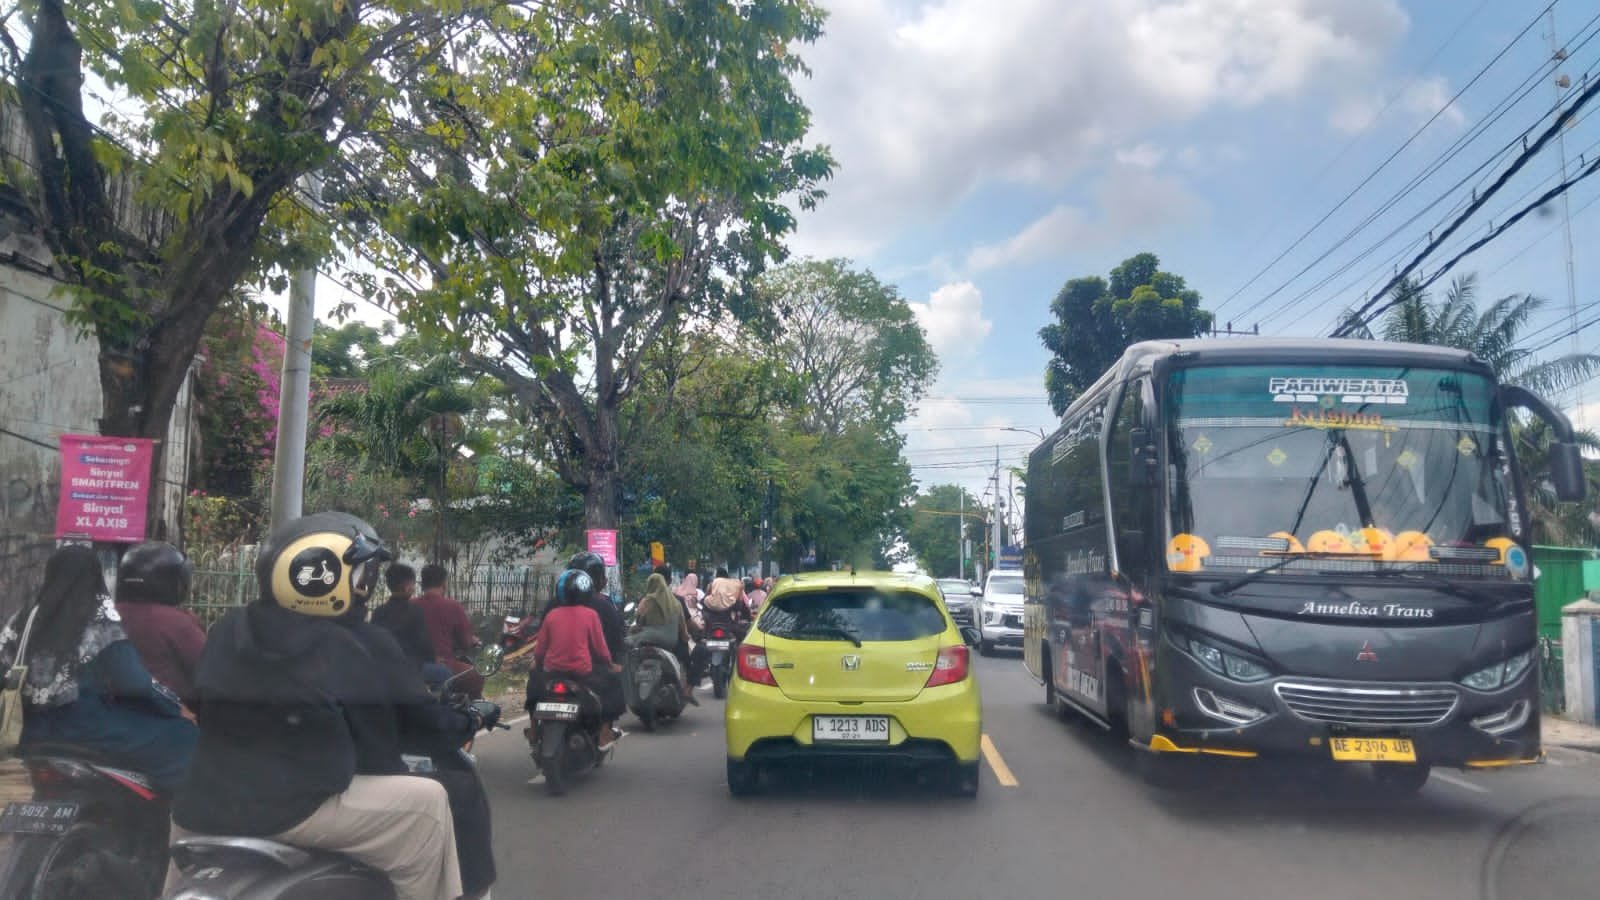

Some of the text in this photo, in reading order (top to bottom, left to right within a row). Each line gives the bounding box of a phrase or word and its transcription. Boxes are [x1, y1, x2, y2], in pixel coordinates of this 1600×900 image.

[1269, 377, 1409, 396] PARIWISATA
[90, 467, 124, 478] Sinyal
[71, 478, 139, 489] SMARTFREN
[82, 502, 124, 516] Sinyal
[75, 516, 128, 529] XL AXIS
[1298, 600, 1434, 618] Annelisa Trans
[815, 718, 887, 732] L 1213 ADS
